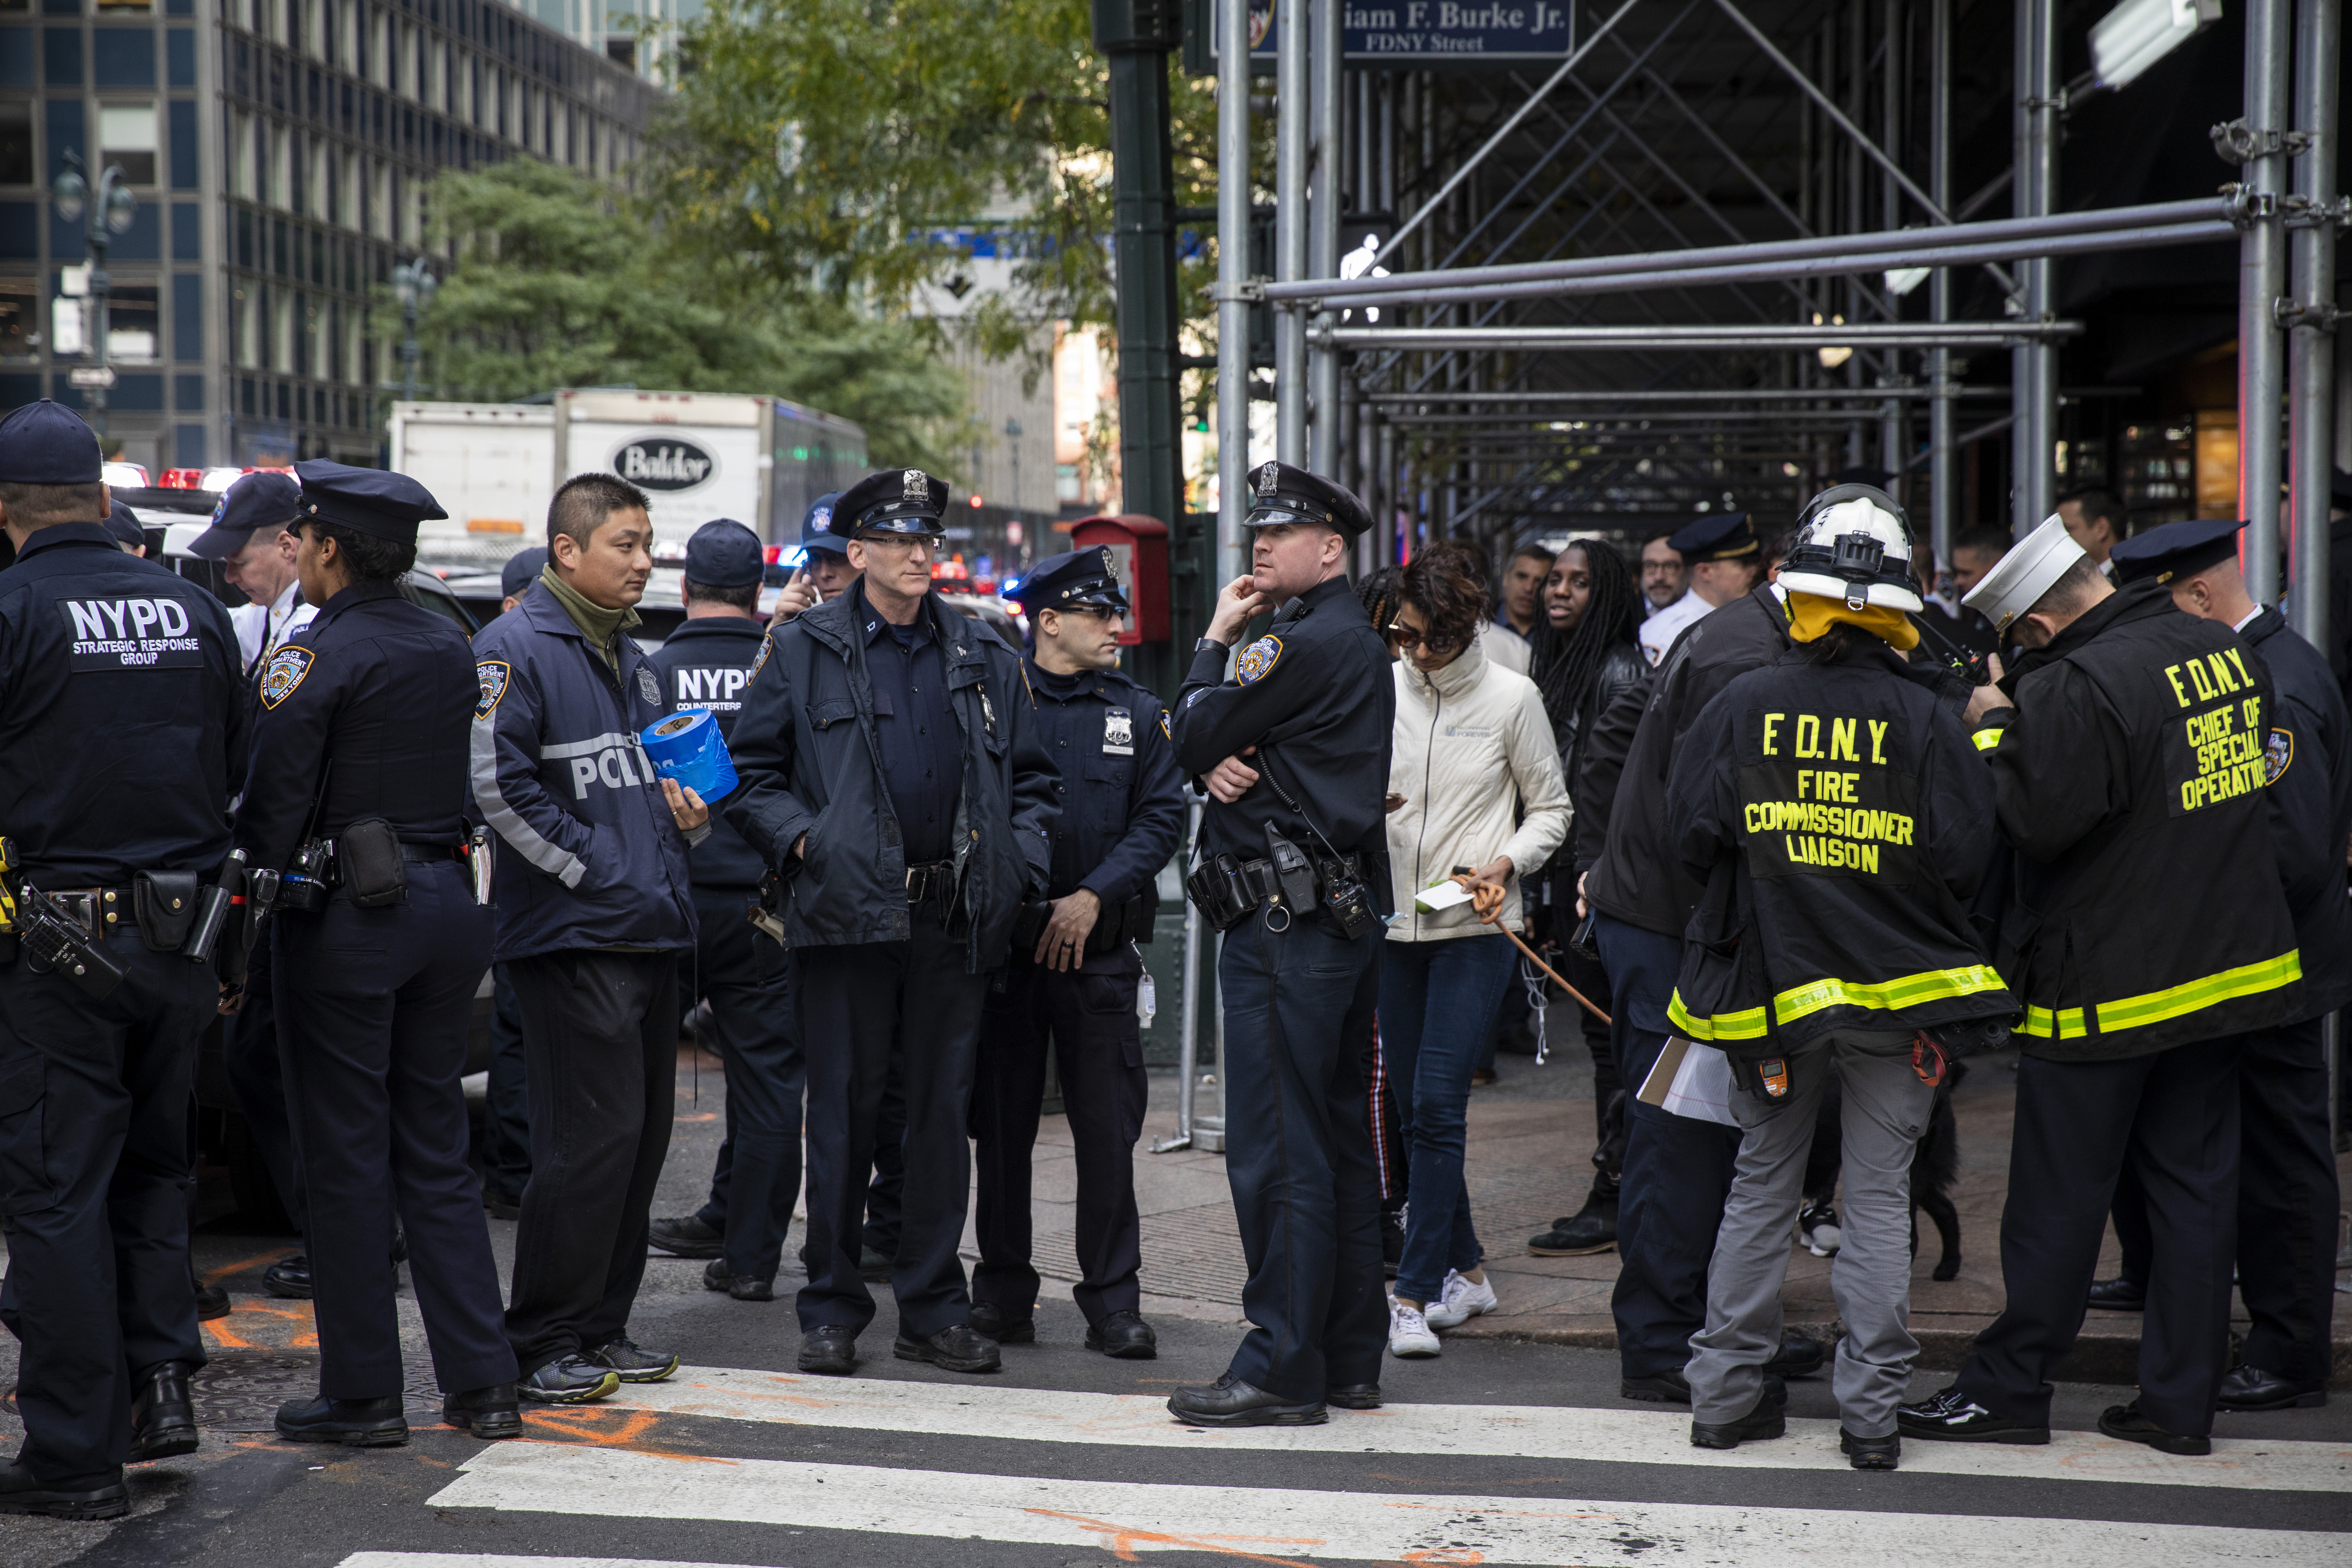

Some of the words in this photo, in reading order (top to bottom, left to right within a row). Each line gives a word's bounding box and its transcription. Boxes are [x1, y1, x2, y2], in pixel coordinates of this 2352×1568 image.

[1407, 1, 1431, 29] F.
[1438, 1, 1525, 29] Burke
[1530, 1, 1566, 34] Jr.
[1366, 33, 1425, 51] FDNY
[1430, 32, 1484, 52] Street
[624, 445, 710, 482] Baldor
[67, 599, 190, 640] NYPD
[73, 640, 137, 654] STRATEGIC
[140, 638, 199, 652] RESPONSE
[1249, 642, 1276, 658] DEPARTMENT
[1258, 638, 1273, 647] POLICE
[120, 652, 159, 665] GROUP
[269, 656, 307, 668] DEPARTMENT
[1248, 672, 1259, 682] NEW
[1260, 660, 1272, 673] YORK
[275, 688, 289, 701] NEW
[288, 672, 305, 689] YORK
[485, 697, 495, 709] NEW
[494, 682, 504, 697] YORK
[644, 692, 659, 701] NYPD
[2186, 704, 2234, 748] CHIEF
[2242, 696, 2261, 729] OF
[2197, 728, 2262, 775] SPECIAL
[570, 746, 655, 800] POLI
[1798, 770, 1860, 803] FIRE
[1745, 801, 1913, 846] COMMISSIONER
[1786, 834, 1878, 874] LIAISON
[52, 942, 70, 962] PROPERTY
